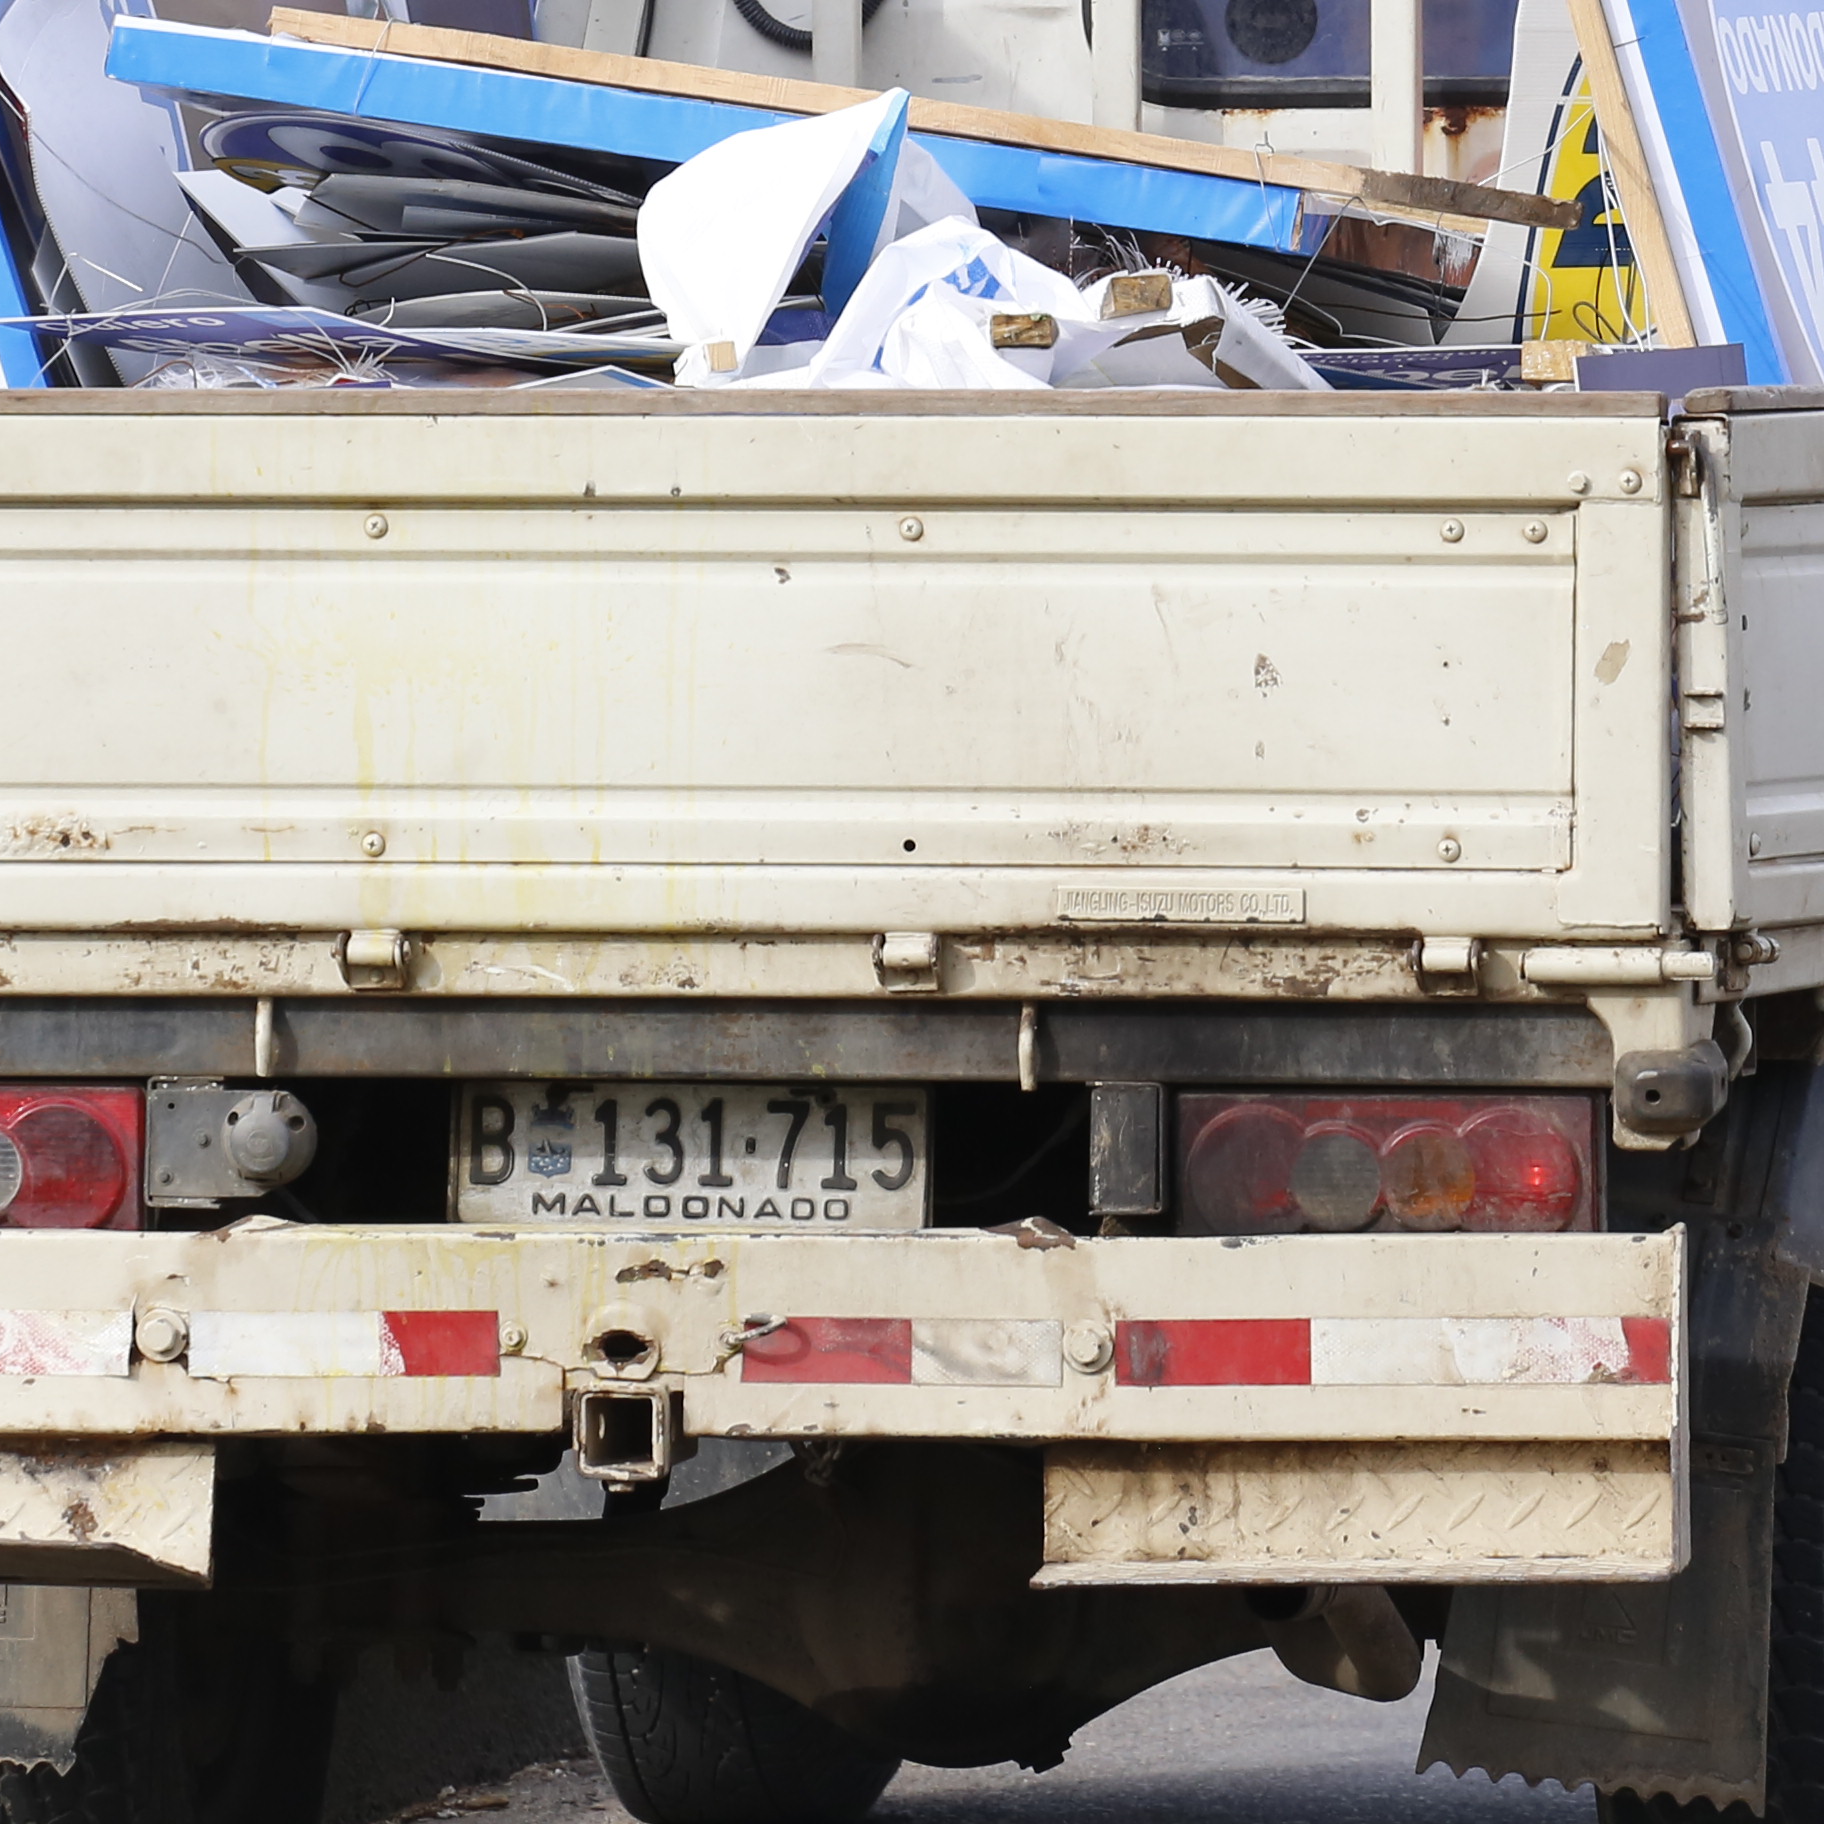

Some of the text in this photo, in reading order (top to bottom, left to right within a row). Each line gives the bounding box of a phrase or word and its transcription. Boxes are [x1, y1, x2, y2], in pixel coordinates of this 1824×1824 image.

[1063, 891, 1174, 913] JIANGLING-ISUZU
[1178, 892, 1235, 914] MOTORS
[469, 1093, 516, 1186] B
[530, 1190, 851, 1221] MALDONADO
